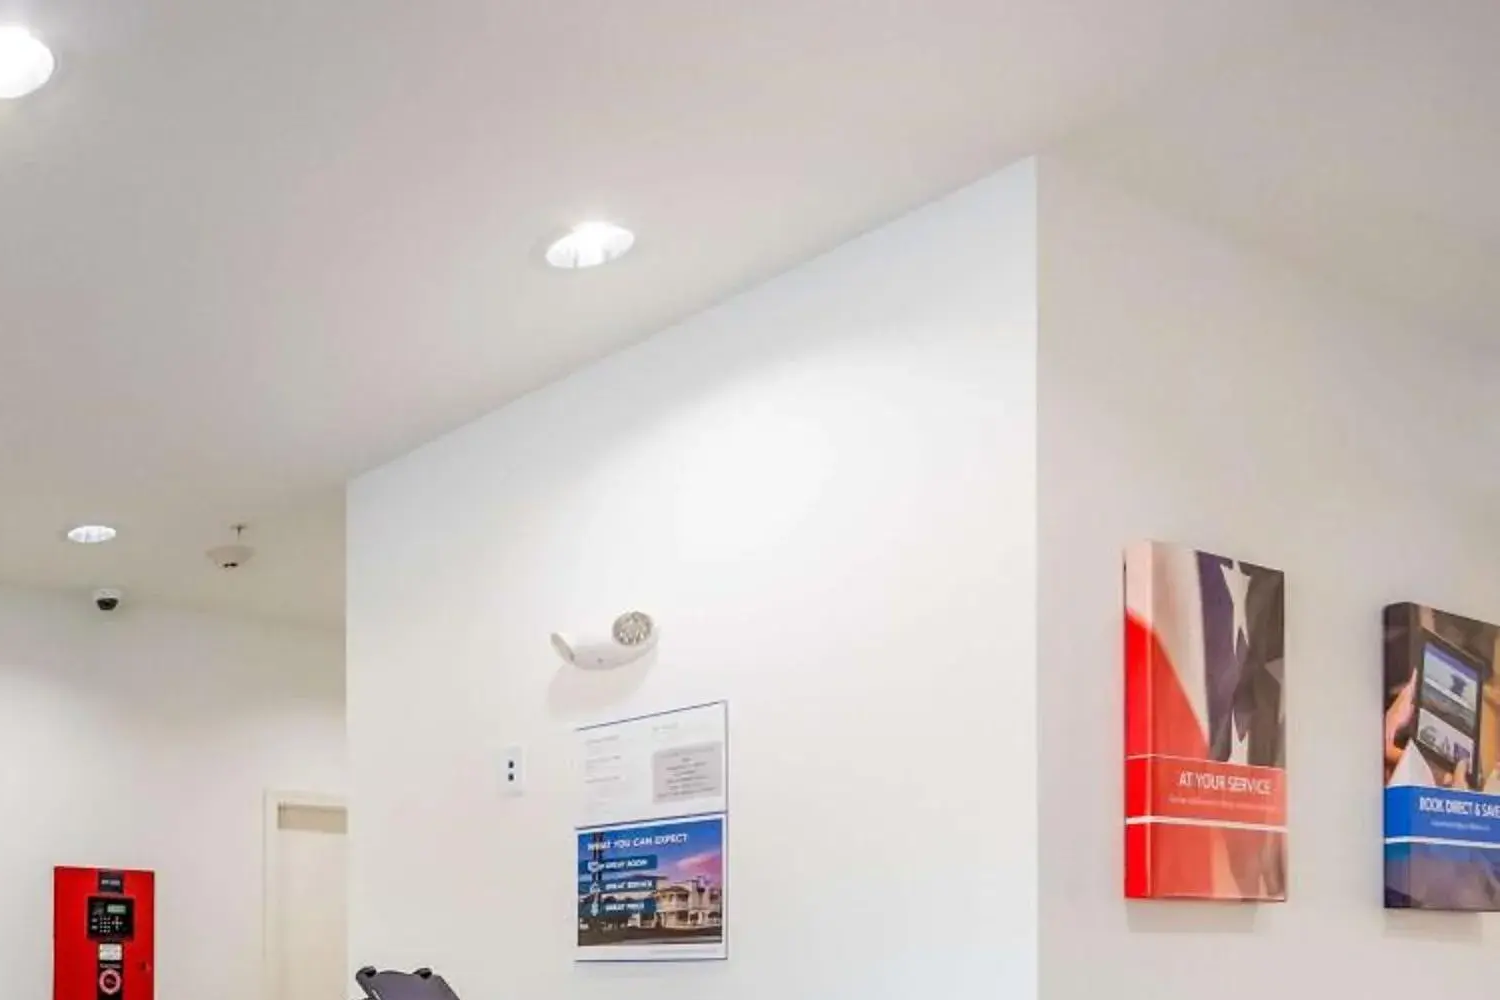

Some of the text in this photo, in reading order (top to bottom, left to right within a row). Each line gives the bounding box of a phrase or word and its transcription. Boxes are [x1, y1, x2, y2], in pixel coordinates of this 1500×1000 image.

[1179, 770, 1273, 795] AT YOUR SERVICE
[612, 838, 631, 849] YOU
[633, 836, 653, 847] CAN
[655, 833, 688, 845] EXPECT
